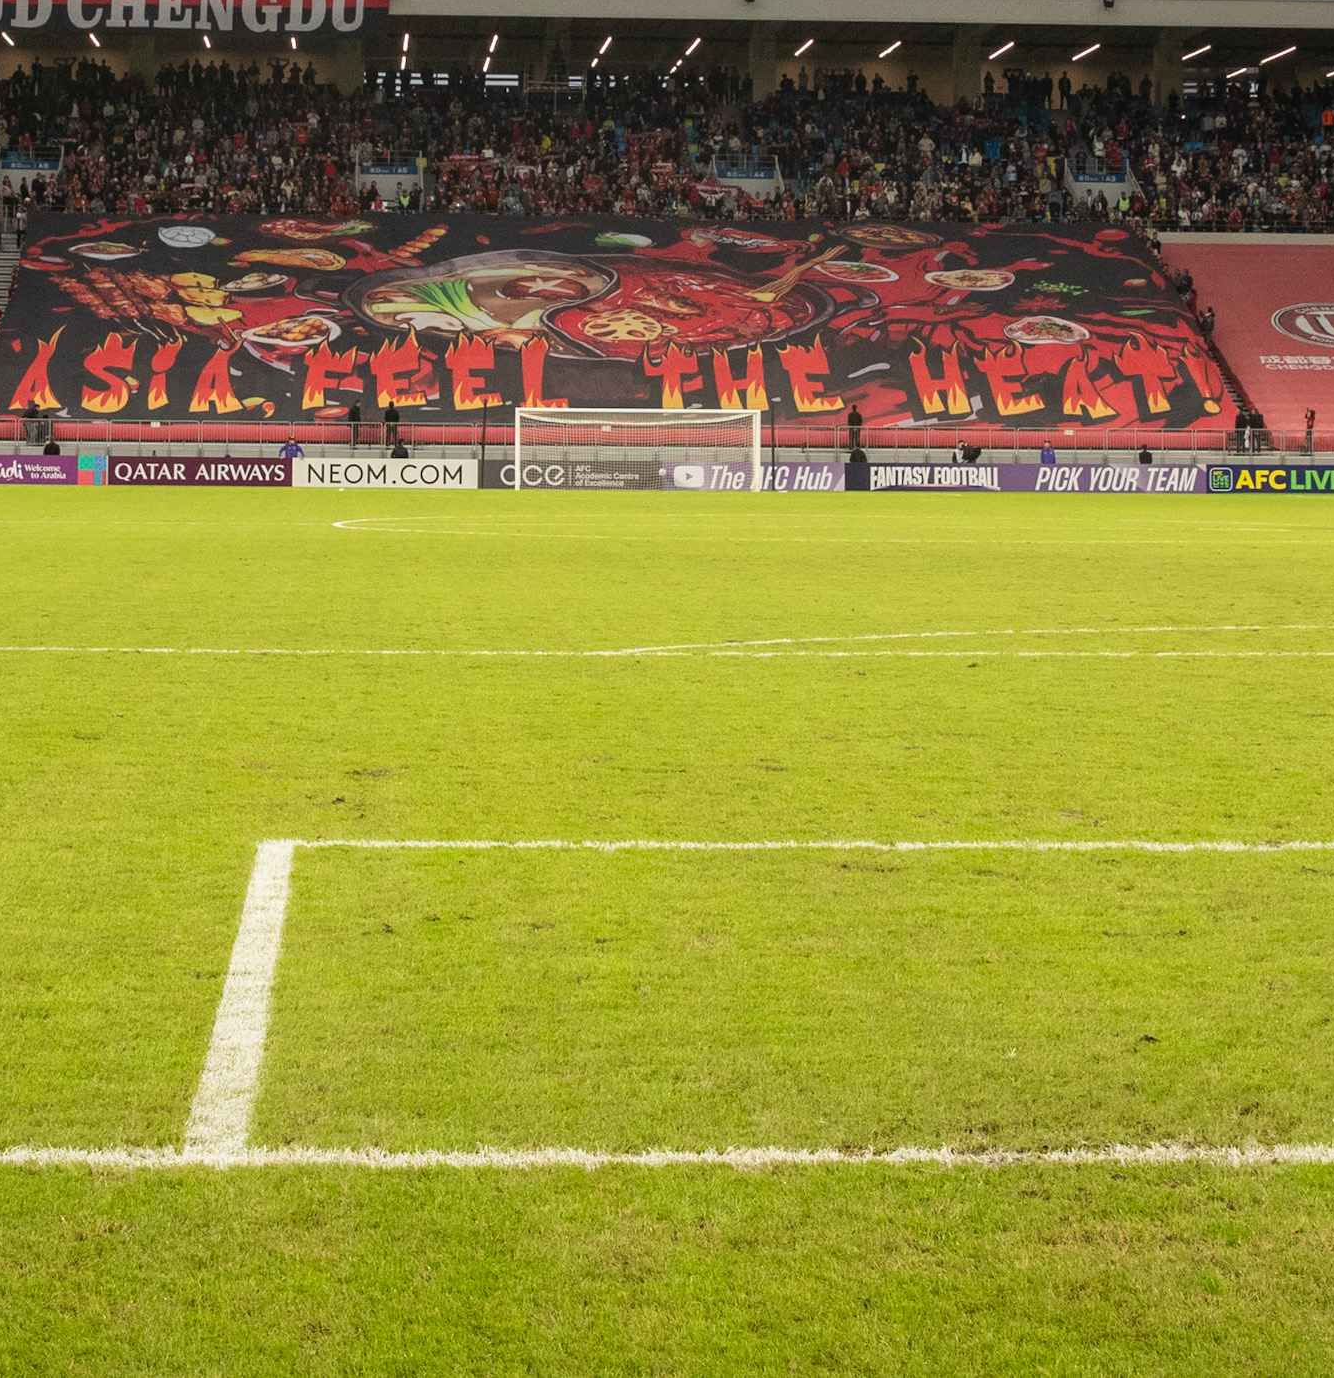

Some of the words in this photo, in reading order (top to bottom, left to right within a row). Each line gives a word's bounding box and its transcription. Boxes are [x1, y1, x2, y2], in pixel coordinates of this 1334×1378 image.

[302, 324, 569, 412] FEEL
[643, 333, 845, 413] THE
[909, 330, 1223, 419] HEAT!
[24, 464, 61, 473] Welcome
[40, 472, 67, 480] Arabia
[115, 462, 186, 483] QATAR
[194, 462, 285, 483] AIRWAYS
[307, 462, 463, 485] NEOM.COM
[711, 466, 745, 489] The
[793, 466, 833, 490] Hub
[870, 466, 930, 490] FANTASY
[933, 466, 1000, 490] FOOTBALL
[1036, 467, 1083, 491] PICK
[1089, 467, 1139, 491] YOUR
[1145, 468, 1198, 492] TEAM
[1236, 470, 1286, 489] AFC
